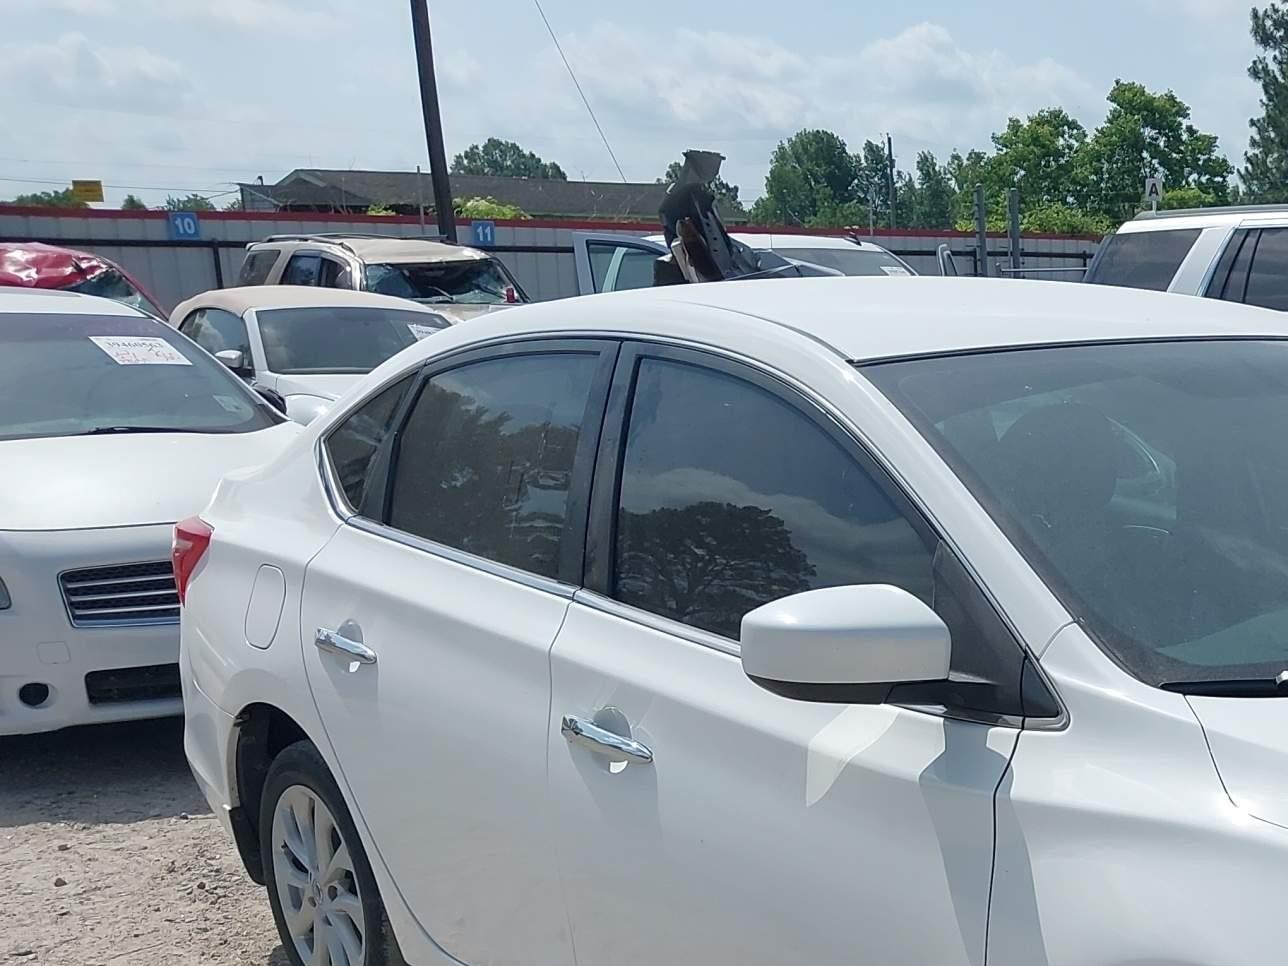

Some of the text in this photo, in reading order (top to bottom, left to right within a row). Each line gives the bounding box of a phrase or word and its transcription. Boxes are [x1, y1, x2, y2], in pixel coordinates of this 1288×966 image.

[1149, 182, 1159, 196] A
[175, 217, 195, 234] 10
[476, 225, 491, 241] 11
